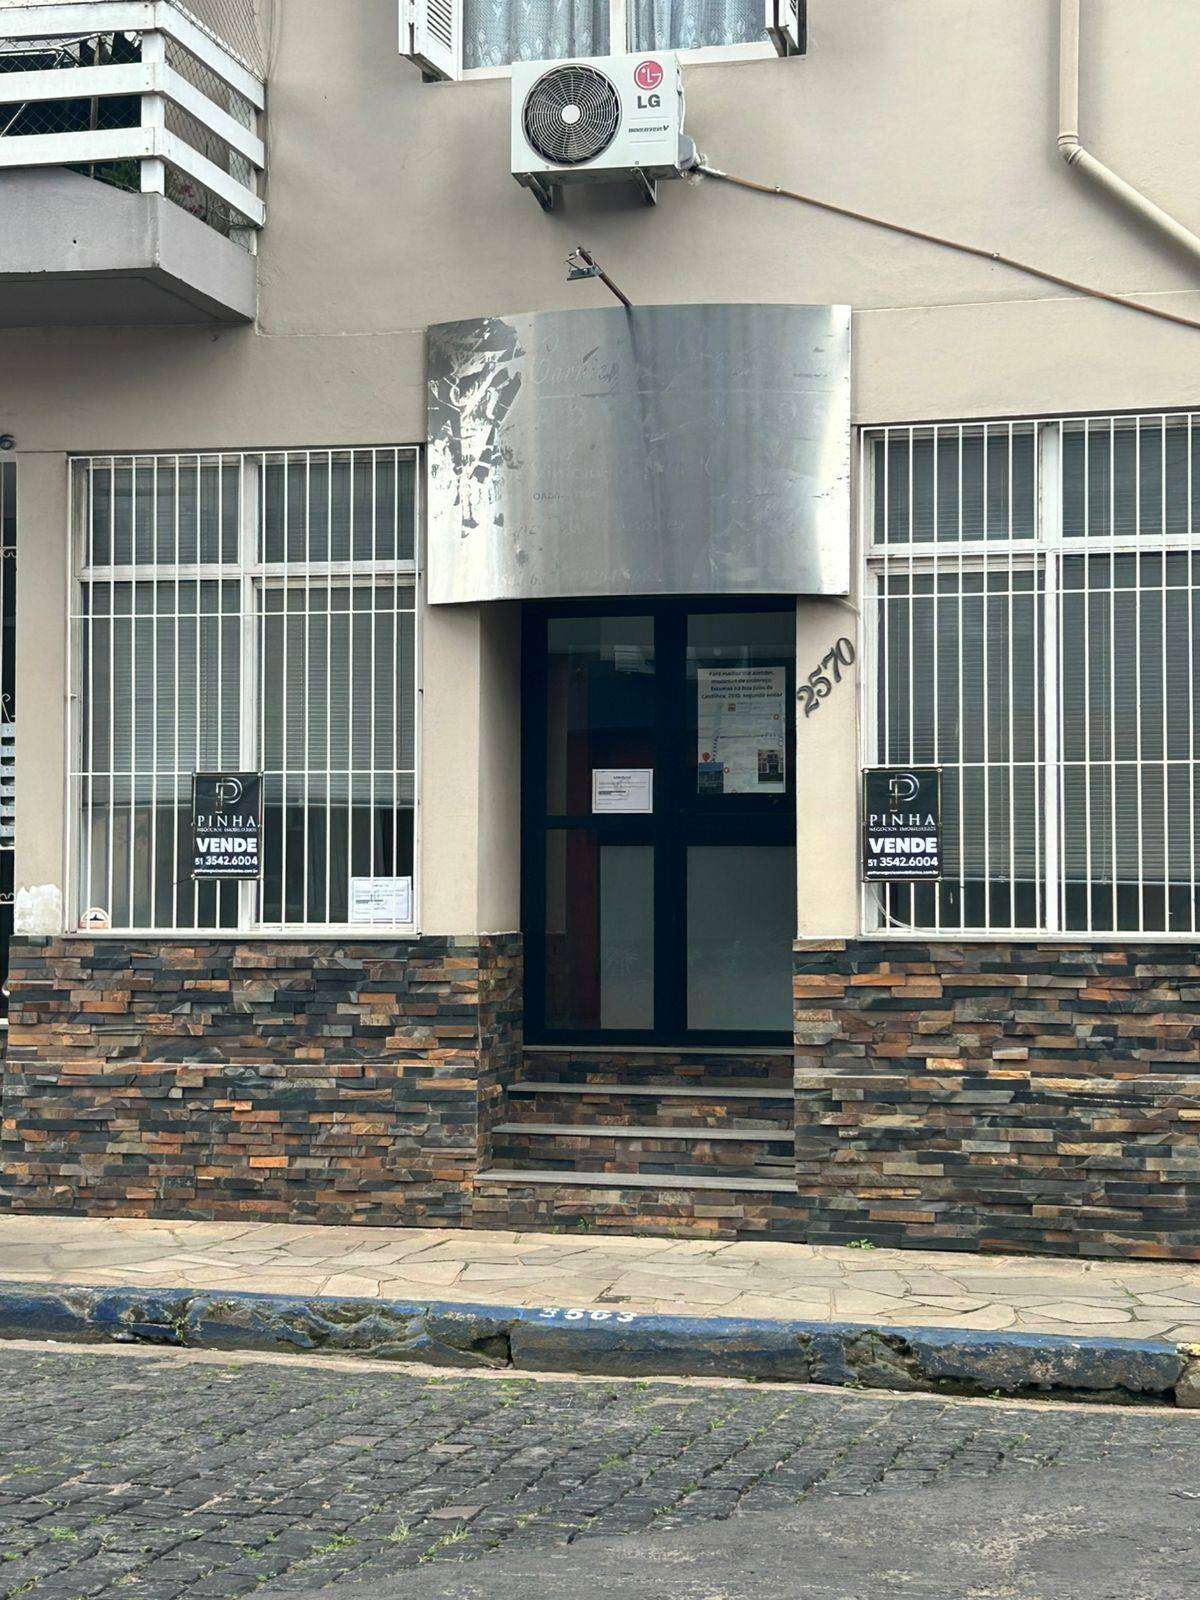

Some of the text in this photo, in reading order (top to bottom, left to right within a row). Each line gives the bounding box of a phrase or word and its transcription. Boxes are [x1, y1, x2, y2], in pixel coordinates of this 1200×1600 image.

[637, 94, 661, 109] LG
[797, 637, 855, 718] 2570
[197, 815, 256, 827] PINHA
[869, 814, 935, 826] PINHA
[196, 837, 258, 853] VENDE
[868, 837, 938, 854] VENDE
[205, 856, 258, 866] 3542.6004
[867, 857, 939, 867] 51 3542.6004
